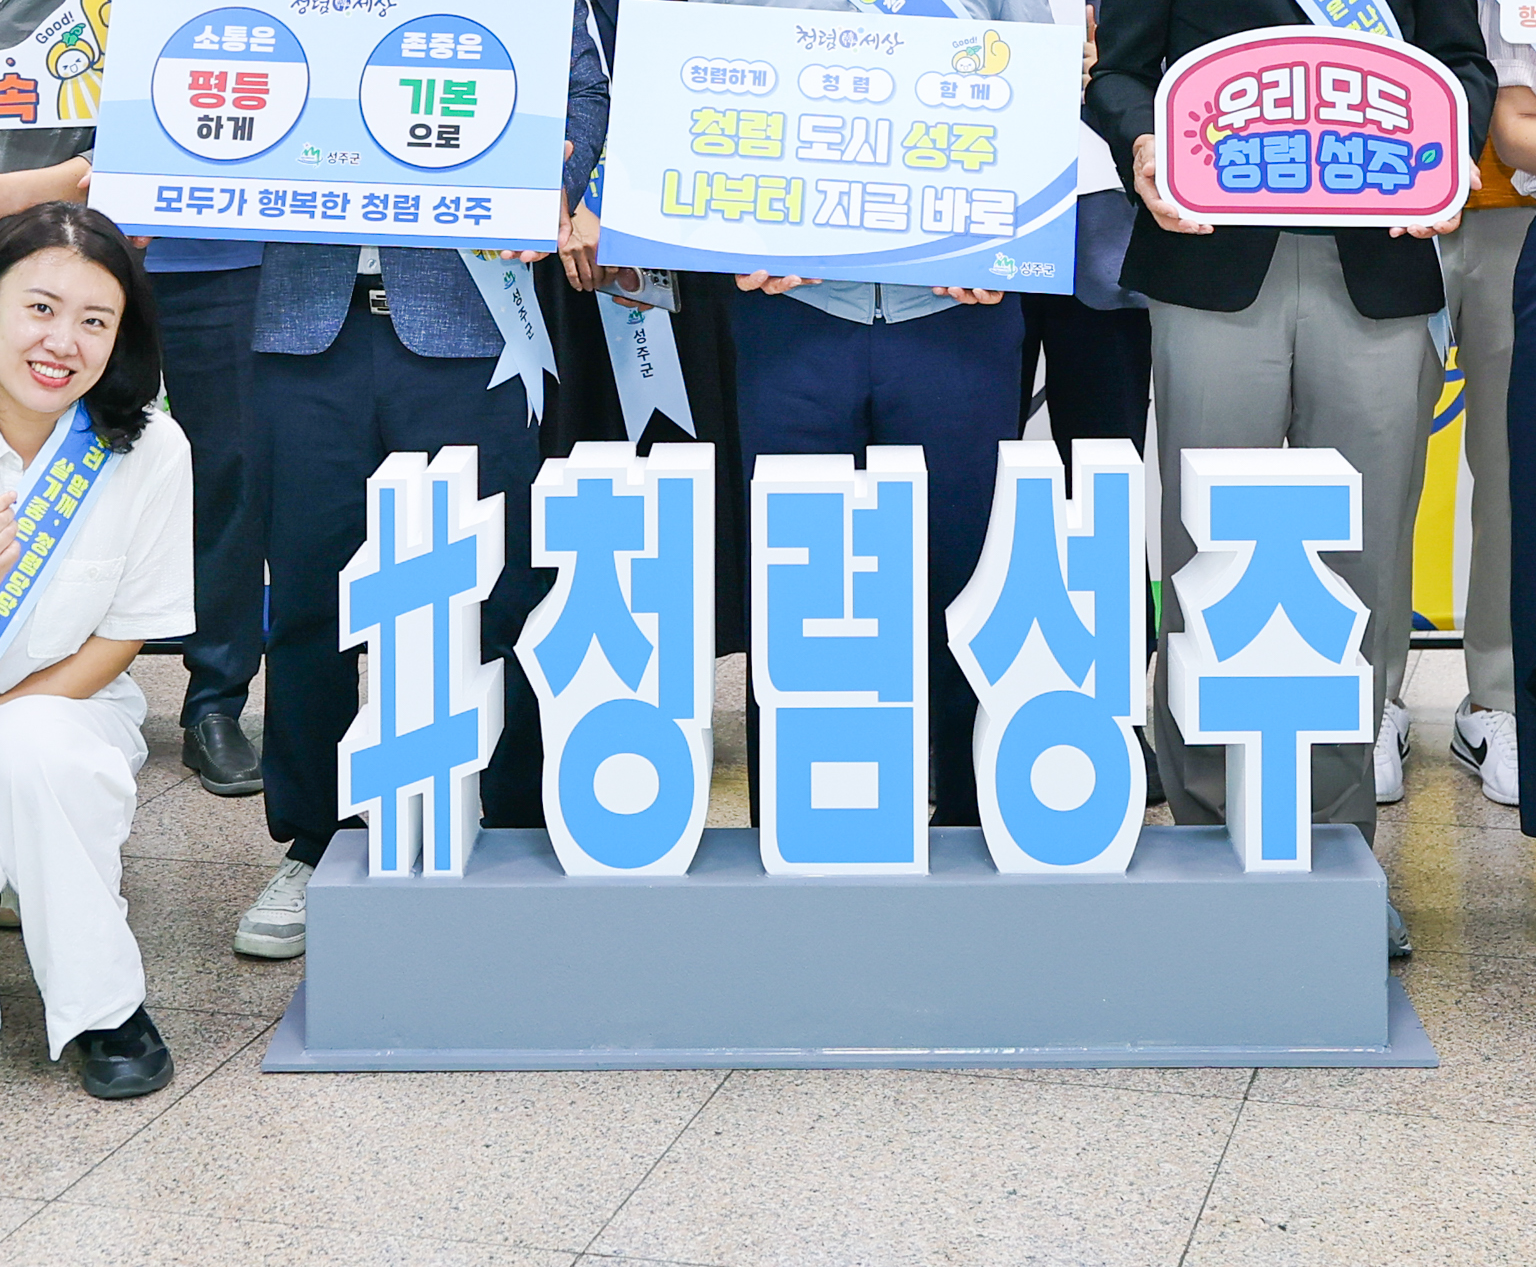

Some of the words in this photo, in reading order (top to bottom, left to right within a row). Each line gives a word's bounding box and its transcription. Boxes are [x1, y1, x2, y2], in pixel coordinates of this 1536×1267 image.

[34, 11, 76, 46] Good!
[192, 25, 277, 53] 소통은
[400, 32, 483, 60] 존중은
[950, 35, 979, 50] Good!
[187, 70, 271, 111] 평등
[689, 66, 768, 89] 청렴하게
[1214, 63, 1308, 129] 우리
[1316, 62, 1412, 133] 모두
[398, 78, 478, 118] 기본
[196, 113, 254, 142] 하게
[406, 123, 461, 149] 으로
[689, 107, 786, 159] 청렴
[795, 113, 892, 166] 도시
[901, 120, 998, 173] 성주
[326, 150, 362, 166] 성주군
[1215, 131, 1311, 193] 청렴
[1317, 131, 1414, 193] 성주
[153, 184, 248, 217] 모두가
[257, 188, 351, 222] 행복한
[361, 192, 421, 223] 청렴
[431, 195, 492, 225] 성주
[660, 168, 806, 225] 나부터
[813, 178, 910, 232] 지금
[921, 185, 1018, 237] 바로
[1019, 261, 1057, 279] 성주군
[511, 288, 534, 341] 성주군
[632, 328, 654, 379] 성주군
[337, 436, 1375, 878] #청렴성주
